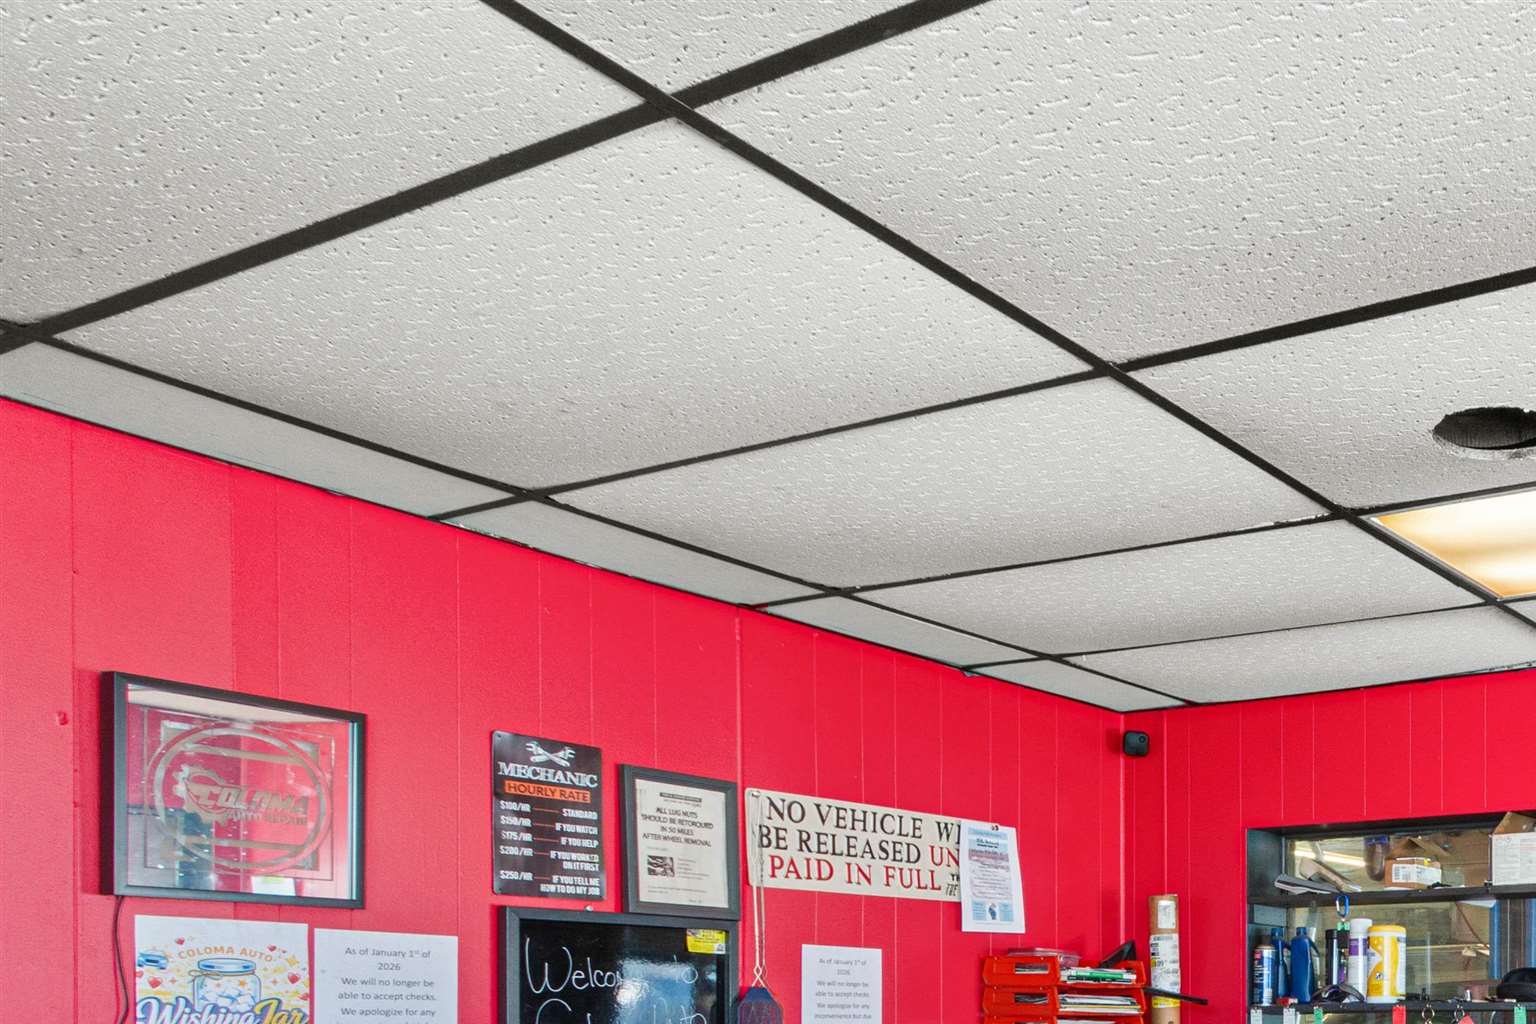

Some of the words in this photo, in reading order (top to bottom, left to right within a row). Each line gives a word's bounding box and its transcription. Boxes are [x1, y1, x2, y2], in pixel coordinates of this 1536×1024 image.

[498, 761, 598, 788] MECHANIC
[508, 782, 556, 797] HOURLY
[560, 788, 589, 802] RATE
[766, 796, 806, 824] NO
[814, 801, 924, 840] VEHICLE
[935, 820, 960, 845] WI
[758, 824, 789, 851] BE
[792, 829, 921, 864] RELEASED
[769, 854, 834, 882] PAID
[846, 862, 872, 886] IN
[884, 866, 942, 892] FULL
[178, 946, 235, 960] COLOMA
[240, 947, 273, 962] AUTO
[344, 947, 357, 956] As
[359, 948, 369, 956] of
[371, 948, 406, 958] January
[422, 950, 431, 958] of
[377, 962, 401, 971] 2026
[525, 936, 623, 994] Welco
[341, 977, 358, 986] We
[360, 978, 377, 986] will
[379, 979, 391, 987] no
[392, 978, 421, 988] longer
[423, 979, 435, 988] be
[338, 992, 359, 1000] able
[361, 992, 372, 1000] to
[373, 993, 404, 1003] accept
[340, 1007, 357, 1016] We
[359, 1008, 403, 1018] apologize
[405, 1008, 418, 1016] for
[420, 1009, 437, 1019] any
